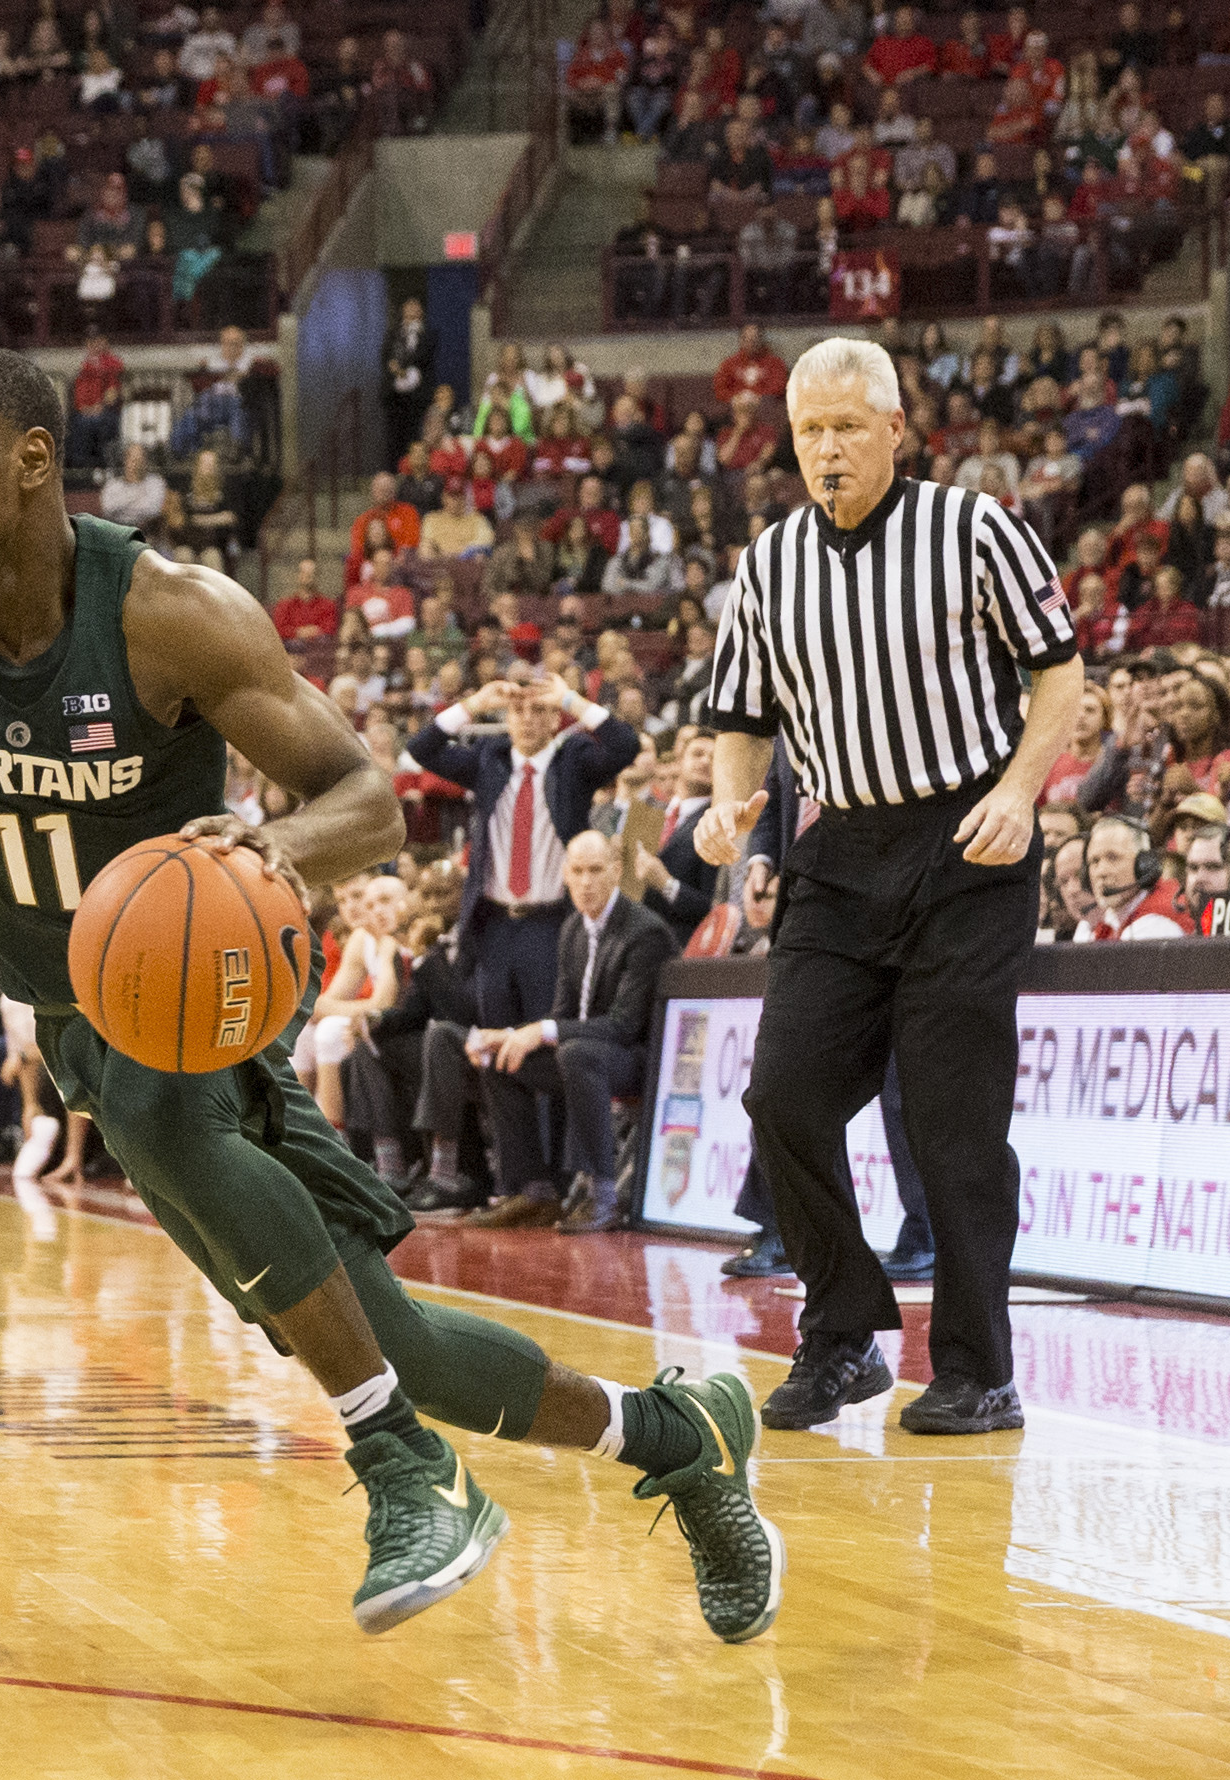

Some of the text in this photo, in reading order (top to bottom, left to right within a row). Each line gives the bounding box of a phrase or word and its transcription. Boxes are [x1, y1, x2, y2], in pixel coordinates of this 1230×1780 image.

[216, 947, 252, 1048] ELITE
[1086, 1172, 1144, 1246] THE
[1149, 1177, 1230, 1256] NATI
